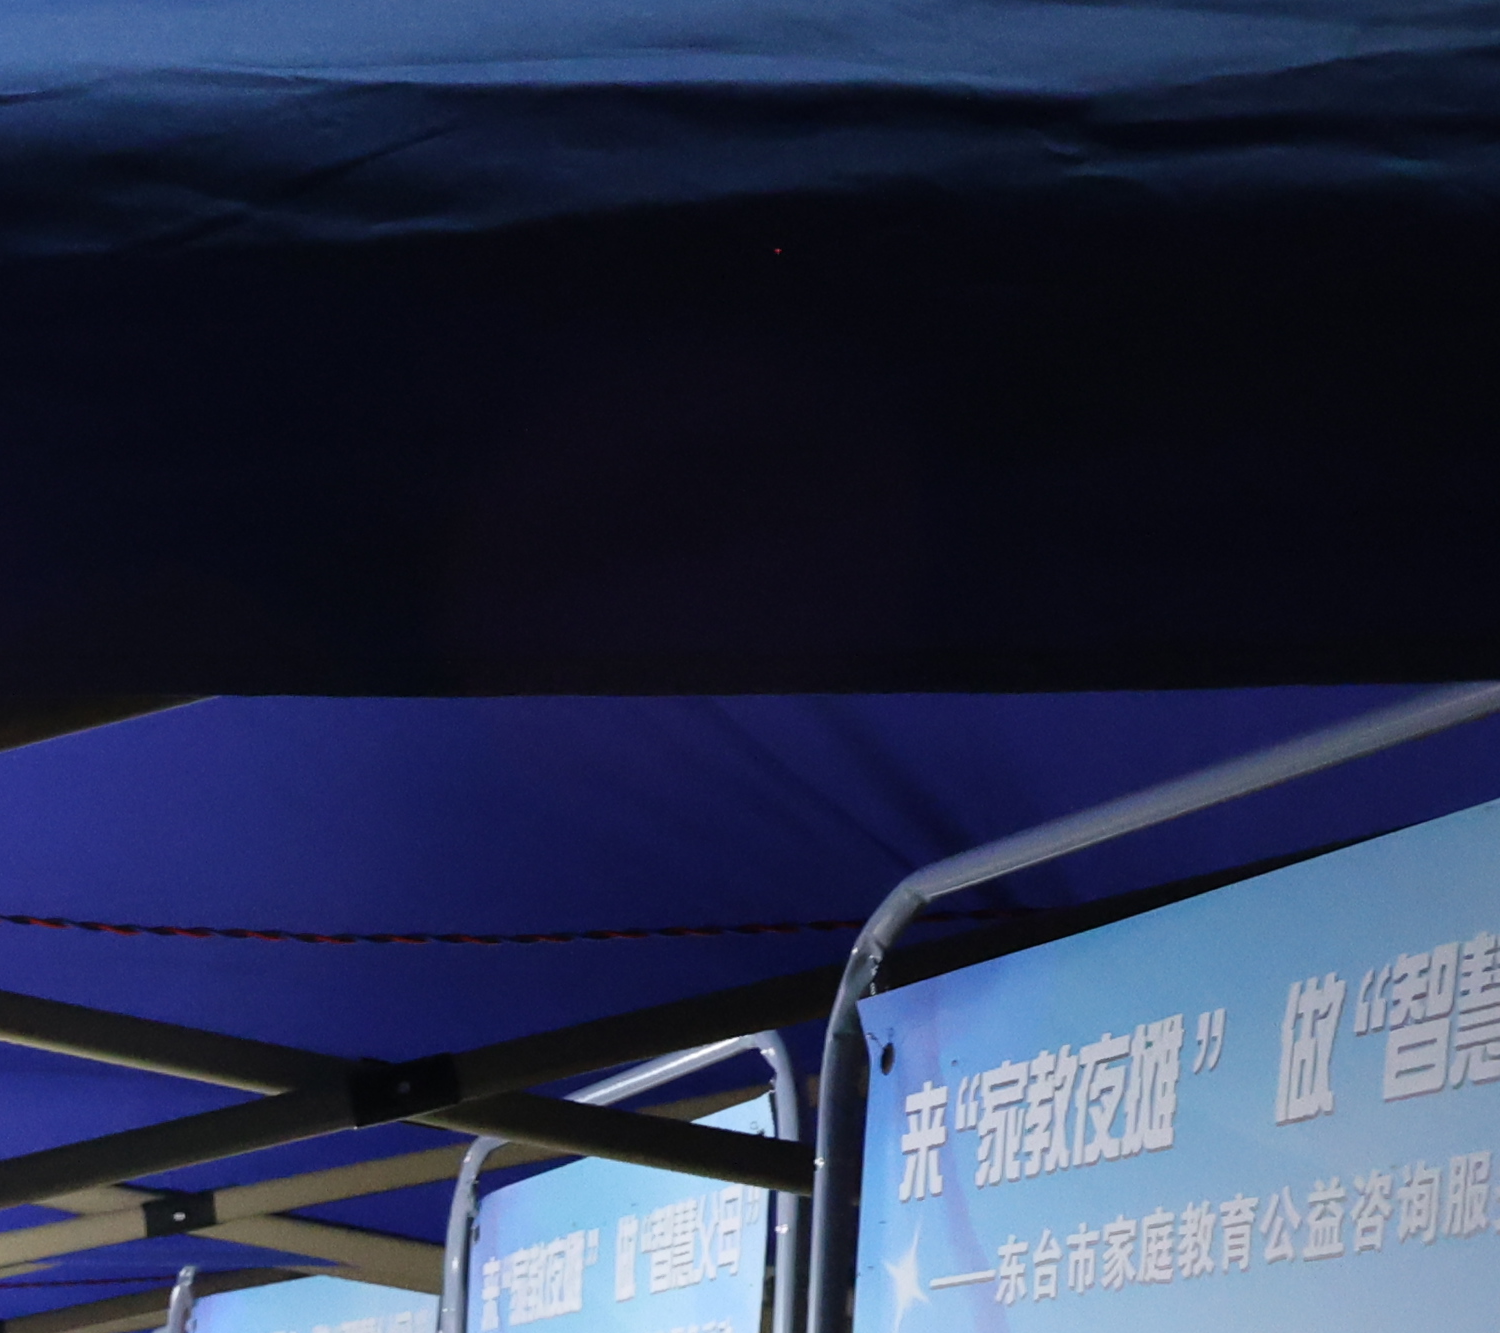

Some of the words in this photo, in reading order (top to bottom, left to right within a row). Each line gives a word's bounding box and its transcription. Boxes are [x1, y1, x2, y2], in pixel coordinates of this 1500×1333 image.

[899, 1006, 1228, 1202] 来“家教夜摊”
[930, 1151, 1500, 1307] ——东台市家庭教育公益咨询服
